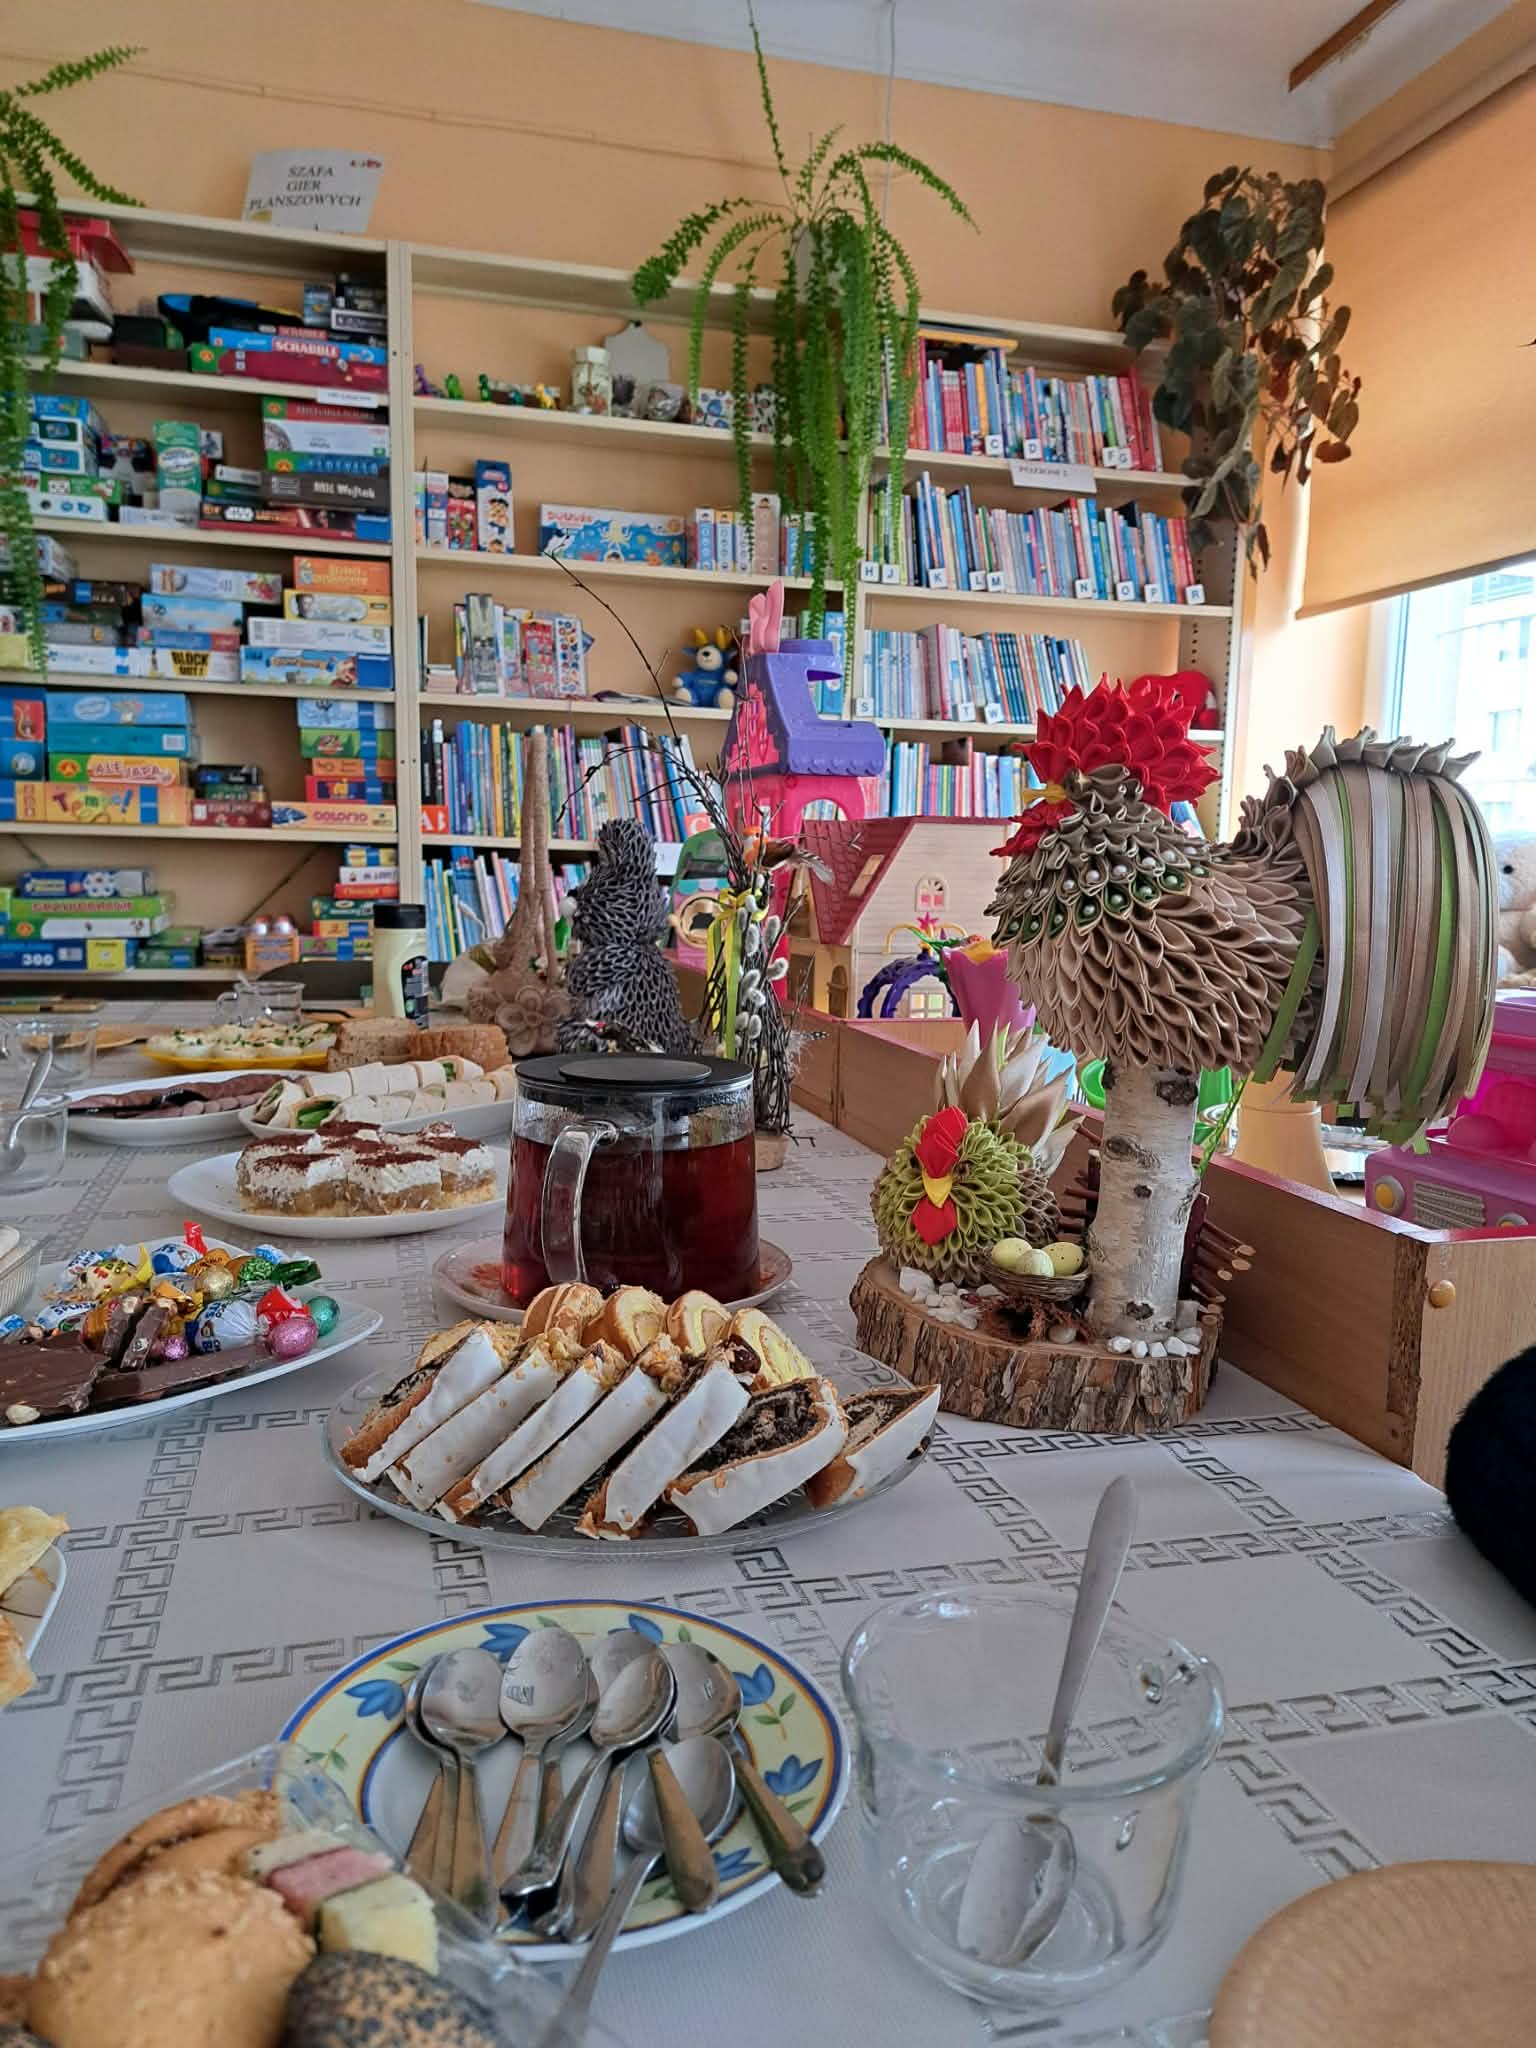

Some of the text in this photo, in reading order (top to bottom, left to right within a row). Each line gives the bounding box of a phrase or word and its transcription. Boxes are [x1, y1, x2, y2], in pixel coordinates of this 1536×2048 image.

[288, 166, 334, 177] SZAFA
[286, 180, 321, 192] GIER
[249, 194, 361, 210] PLANSZOWYCH
[275, 339, 338, 358] SCRABBLE
[22, 952, 54, 966] 300
